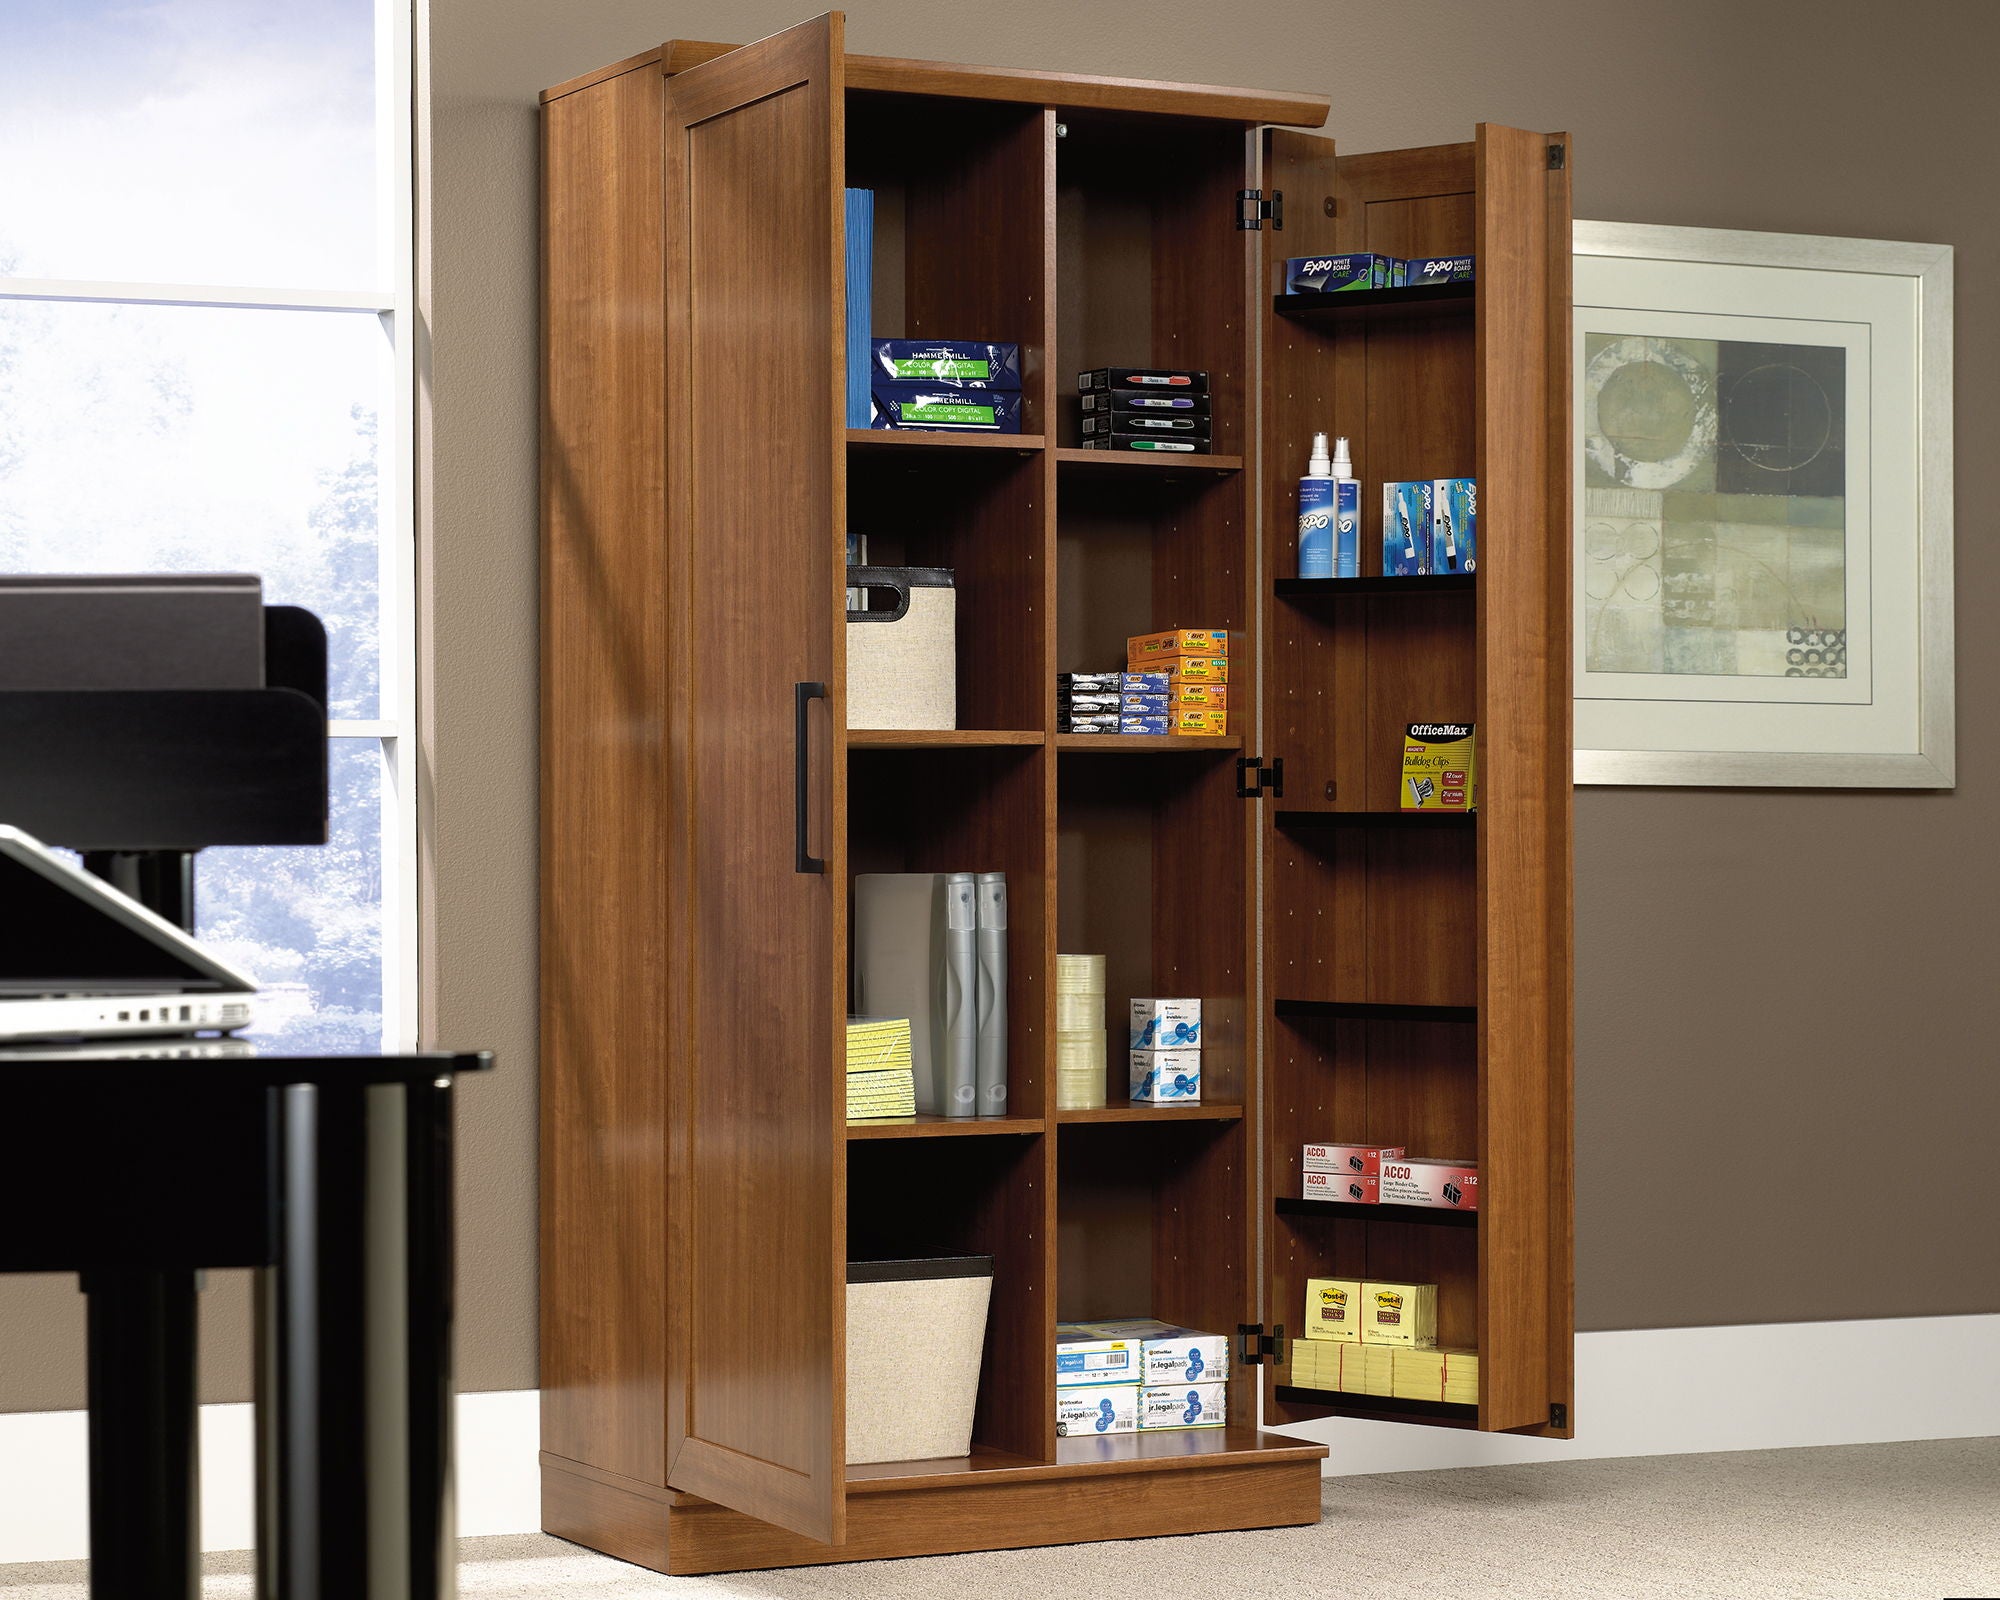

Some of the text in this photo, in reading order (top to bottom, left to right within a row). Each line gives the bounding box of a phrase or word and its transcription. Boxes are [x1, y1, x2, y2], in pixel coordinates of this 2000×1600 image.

[1302, 260, 1333, 276] EXPO
[1423, 261, 1453, 277] EXPO
[1421, 484, 1431, 510] EXPO
[1411, 724, 1468, 736] OfficeMax
[1404, 755, 1450, 769] Bulldog Clips
[1306, 1147, 1326, 1157] ACCO
[1383, 1150, 1394, 1158] ACCO
[1383, 1165, 1411, 1179] ACCO
[1307, 1175, 1326, 1185] ACCO
[1469, 1176, 1478, 1185] 12
[1323, 1292, 1345, 1300] Post-it
[1378, 1295, 1400, 1303] Post-it
